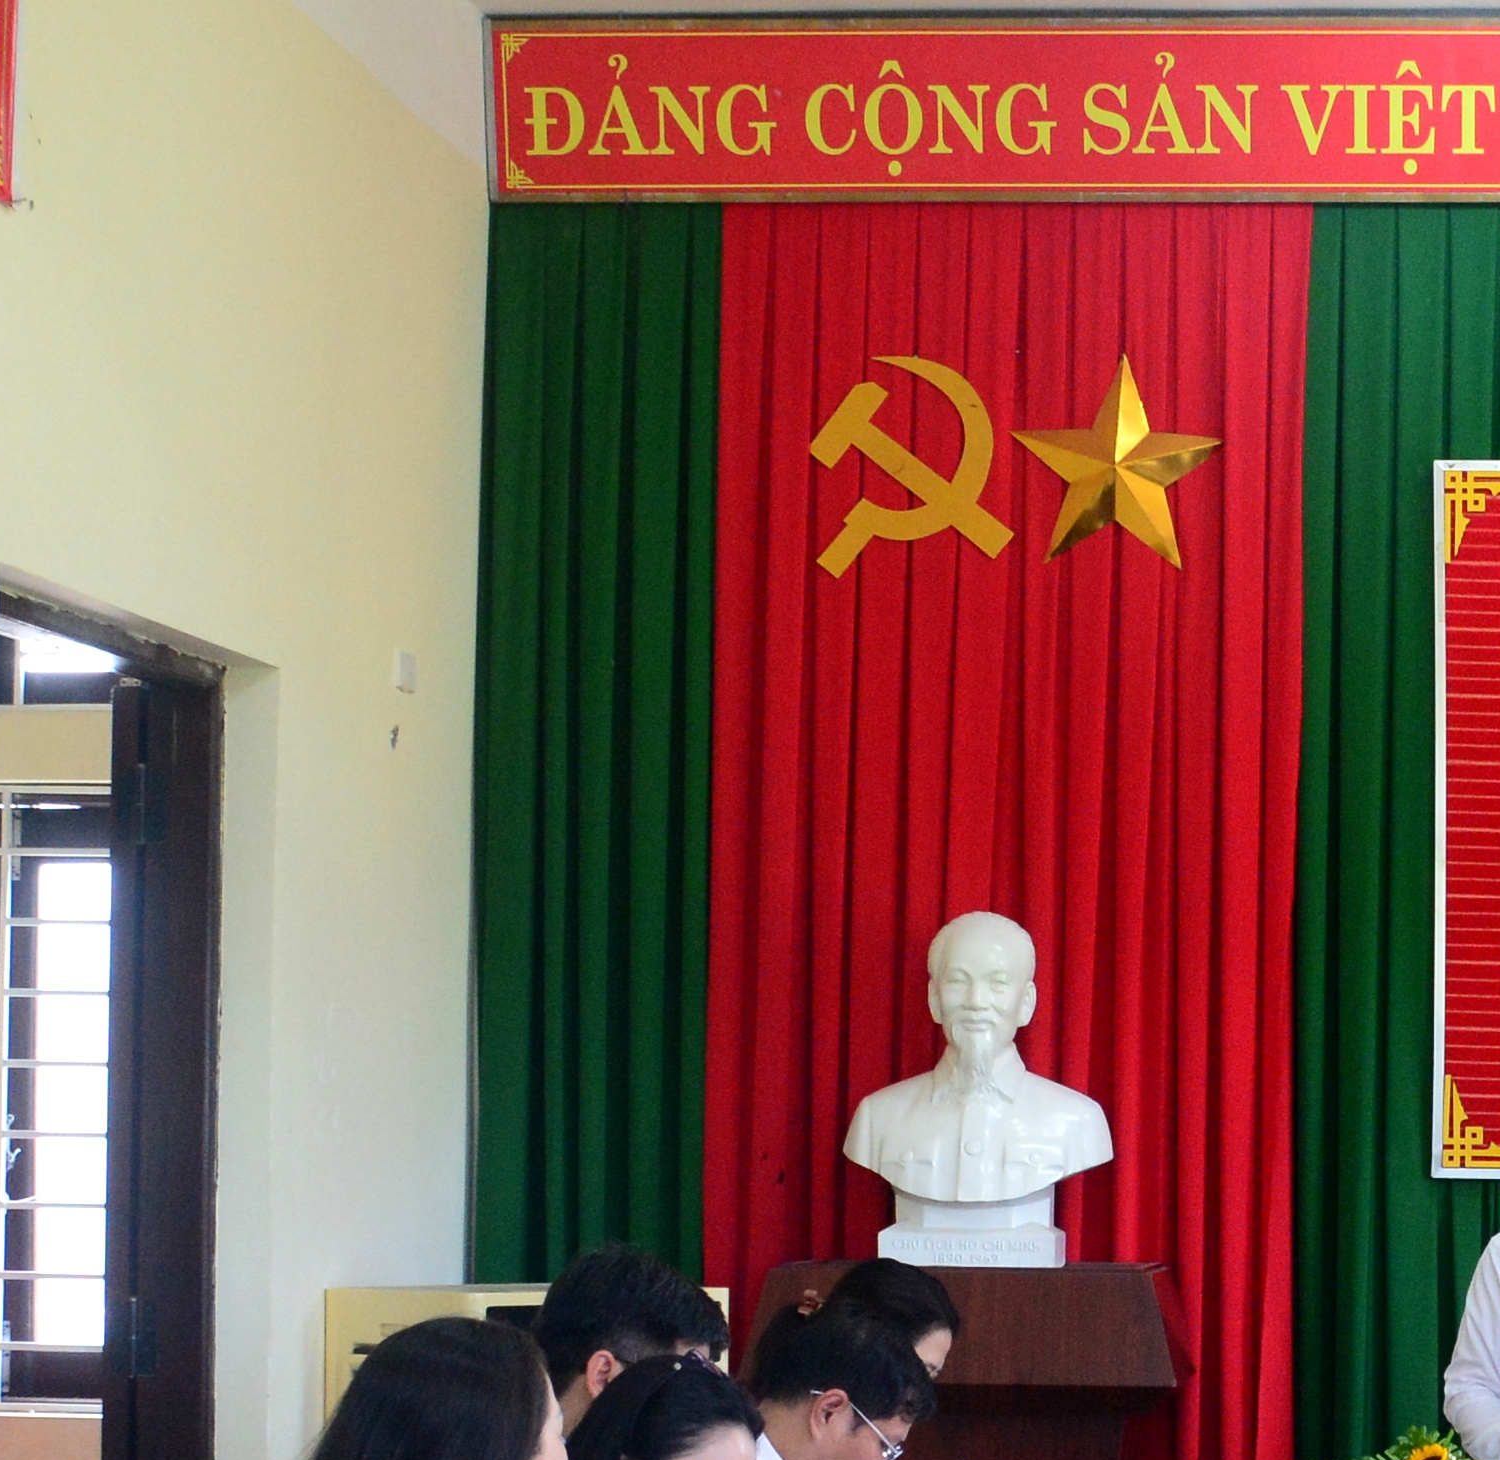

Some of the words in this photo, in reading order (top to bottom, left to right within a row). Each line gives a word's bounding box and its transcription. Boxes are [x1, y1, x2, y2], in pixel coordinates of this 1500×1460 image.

[525, 55, 776, 155] ĐẢNG
[806, 61, 1057, 175] CỘNG
[1084, 52, 1258, 154] SẢN
[1282, 60, 1496, 174] VIỆT
